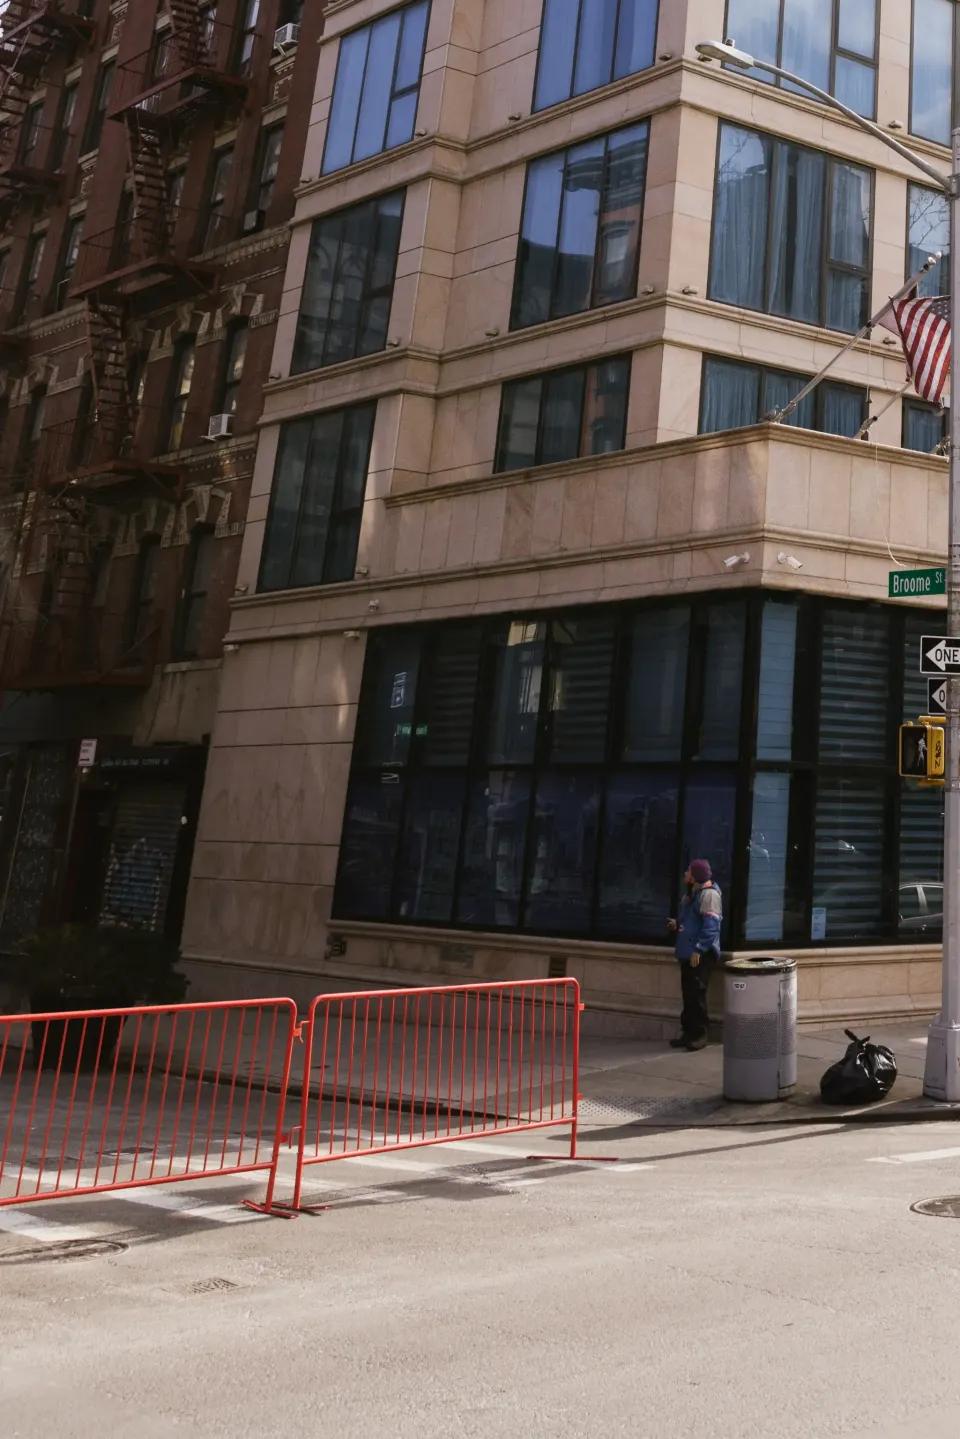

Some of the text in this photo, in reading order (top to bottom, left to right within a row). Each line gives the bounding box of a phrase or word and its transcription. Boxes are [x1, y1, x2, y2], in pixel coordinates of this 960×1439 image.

[893, 571, 943, 593] Broome St
[935, 648, 959, 663] ONE
